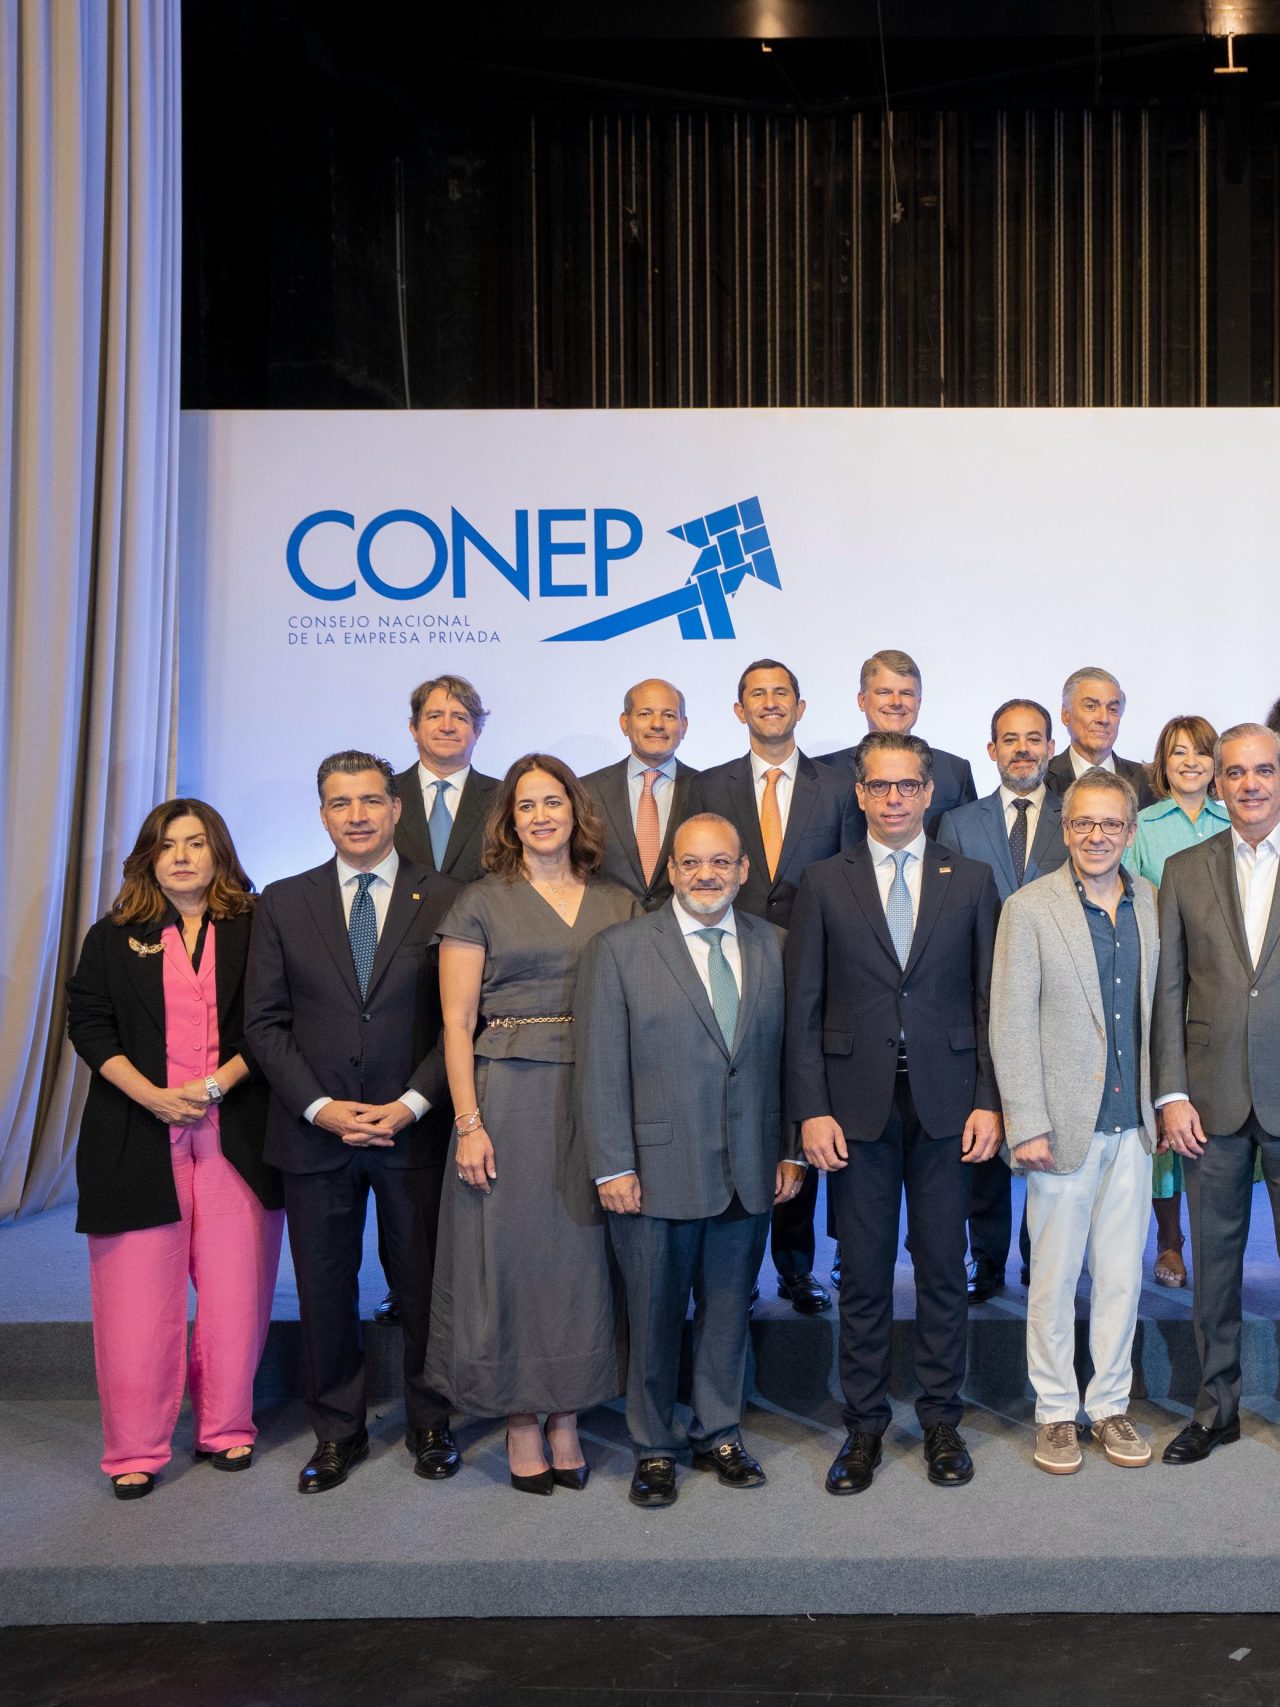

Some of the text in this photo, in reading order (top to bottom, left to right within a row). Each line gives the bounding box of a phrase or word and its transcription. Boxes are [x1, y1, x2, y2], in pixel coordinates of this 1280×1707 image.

[286, 506, 643, 601] CONEP
[288, 615, 471, 628] CONSEJO NACIONAL
[288, 631, 500, 644] DE LA EMPRESA PRIVADA
